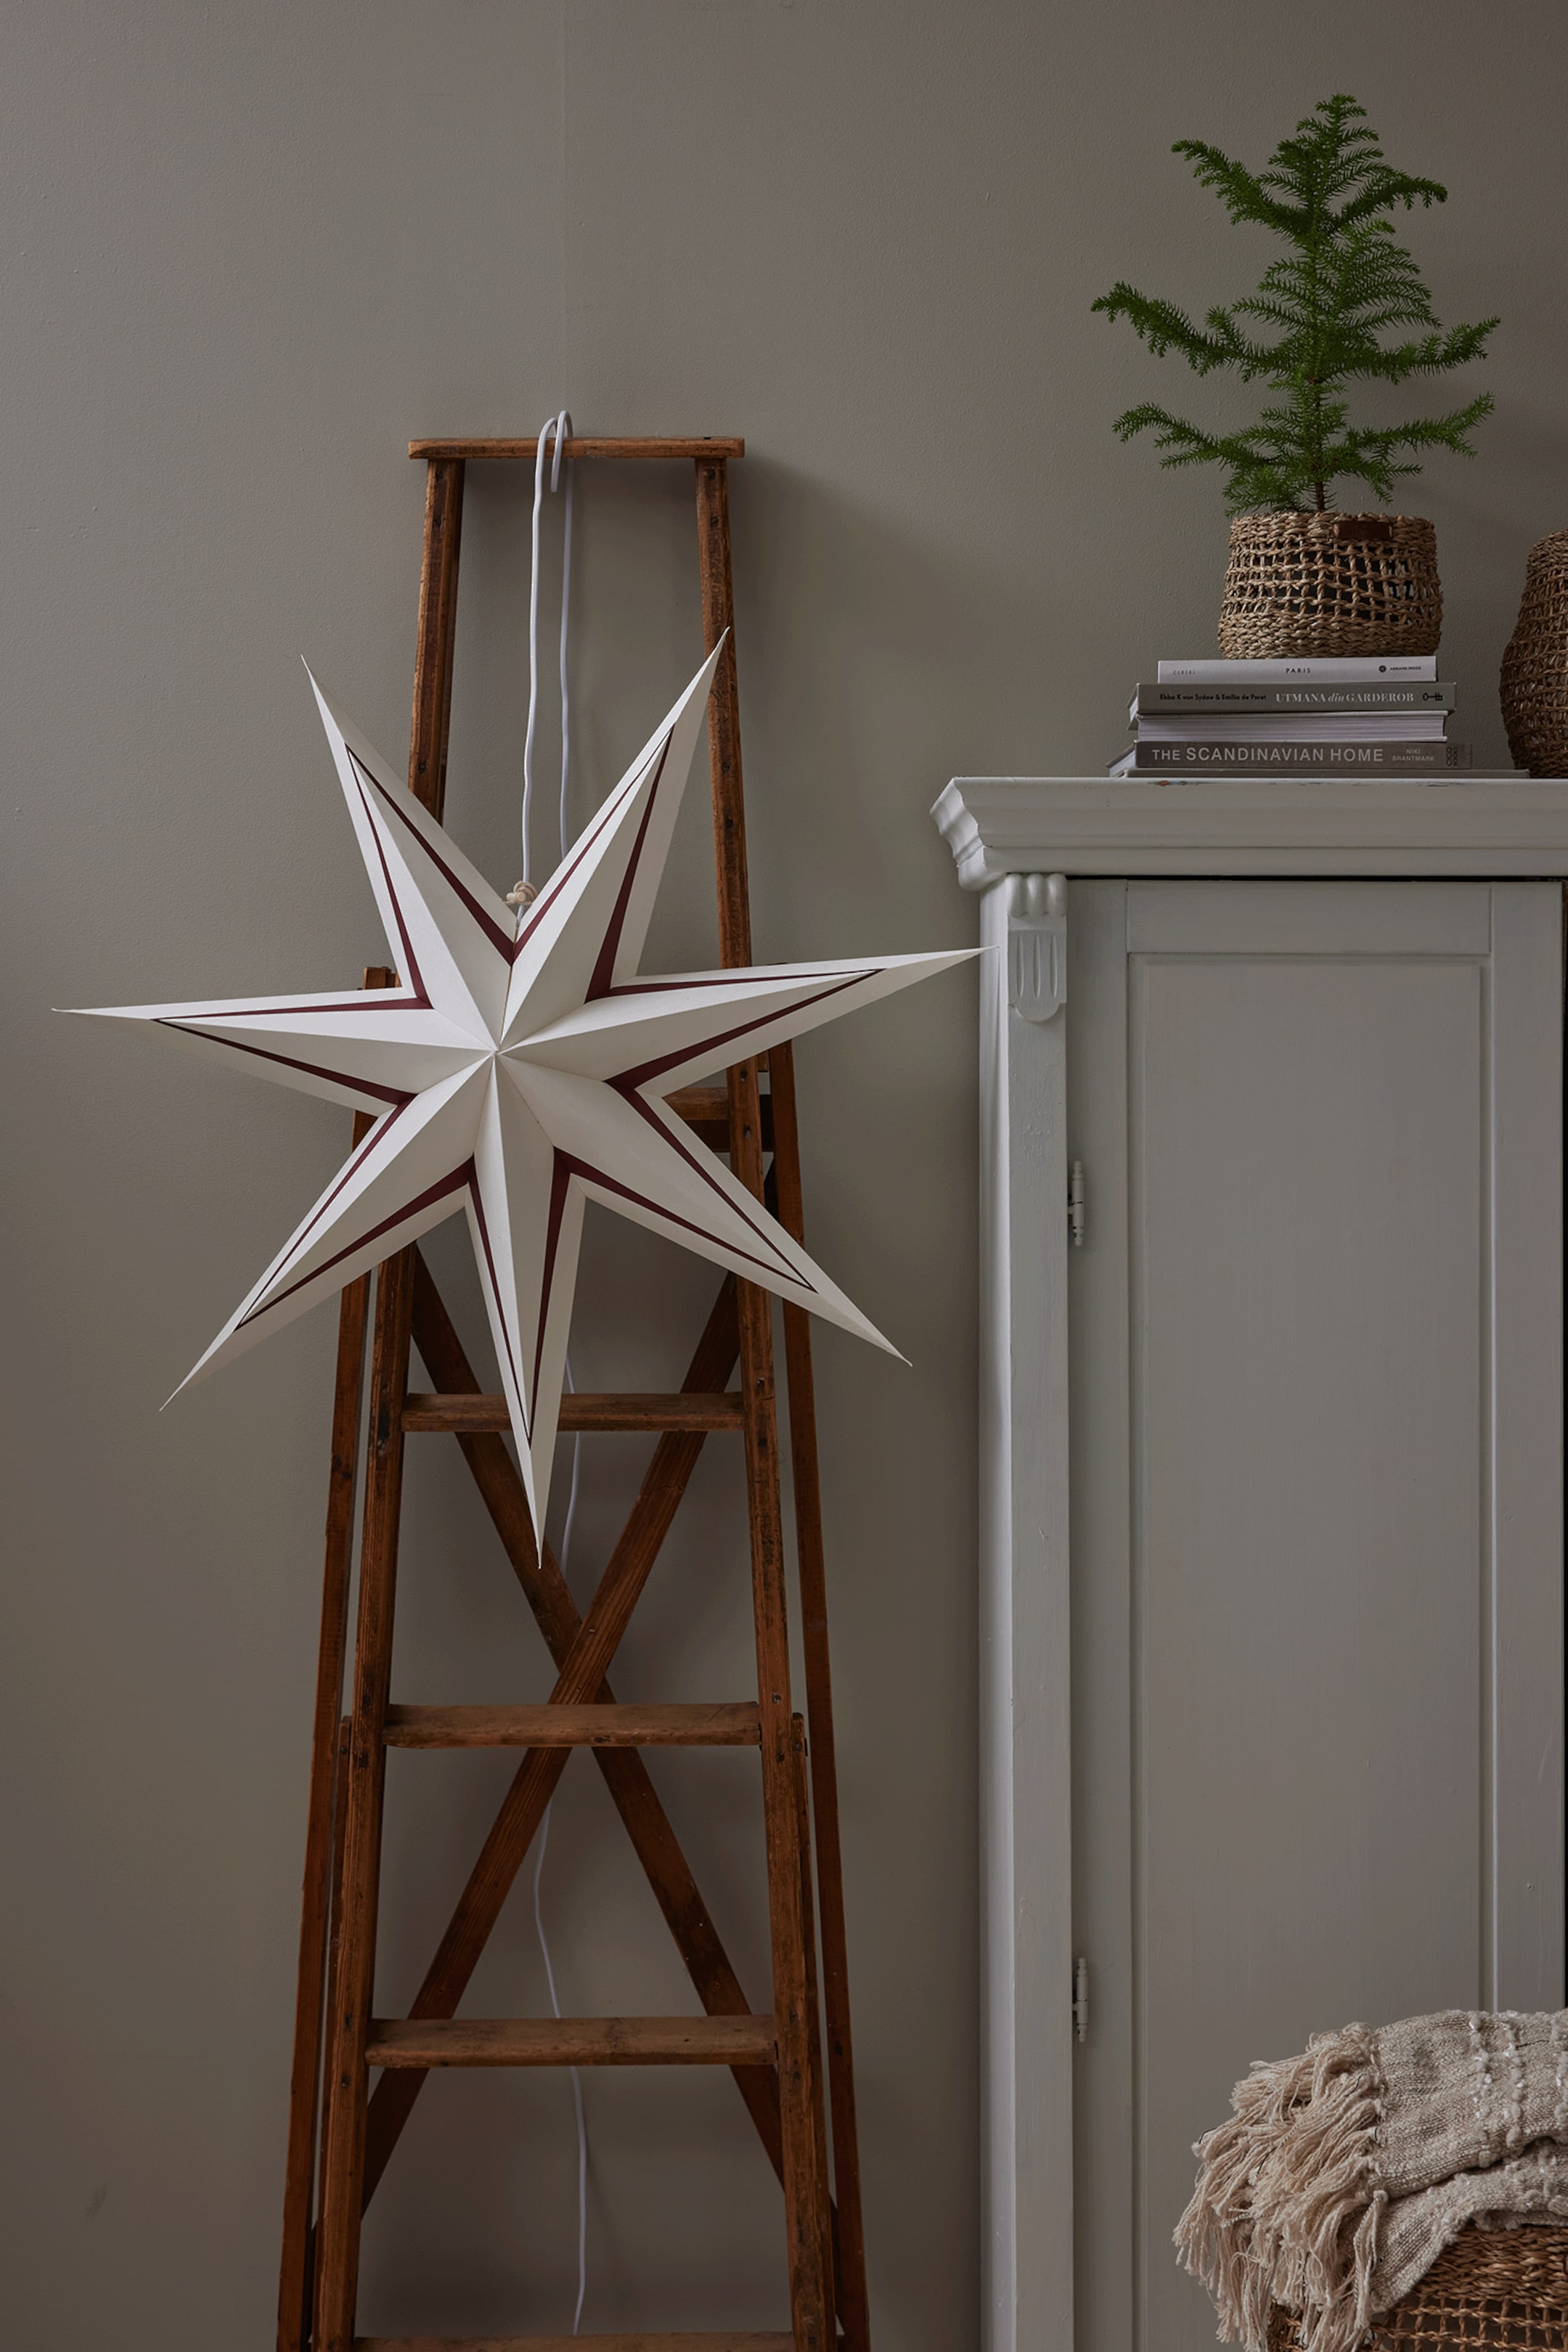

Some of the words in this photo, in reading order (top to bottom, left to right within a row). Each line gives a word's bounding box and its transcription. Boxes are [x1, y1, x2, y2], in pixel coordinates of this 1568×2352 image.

[1275, 693, 1326, 703] UTMANA
[1327, 693, 1344, 702] din
[1345, 693, 1414, 702] GARDEROB
[1152, 749, 1181, 760] THE
[1186, 747, 1323, 761] SCANDINAVIAN
[1331, 748, 1384, 761] HOME
